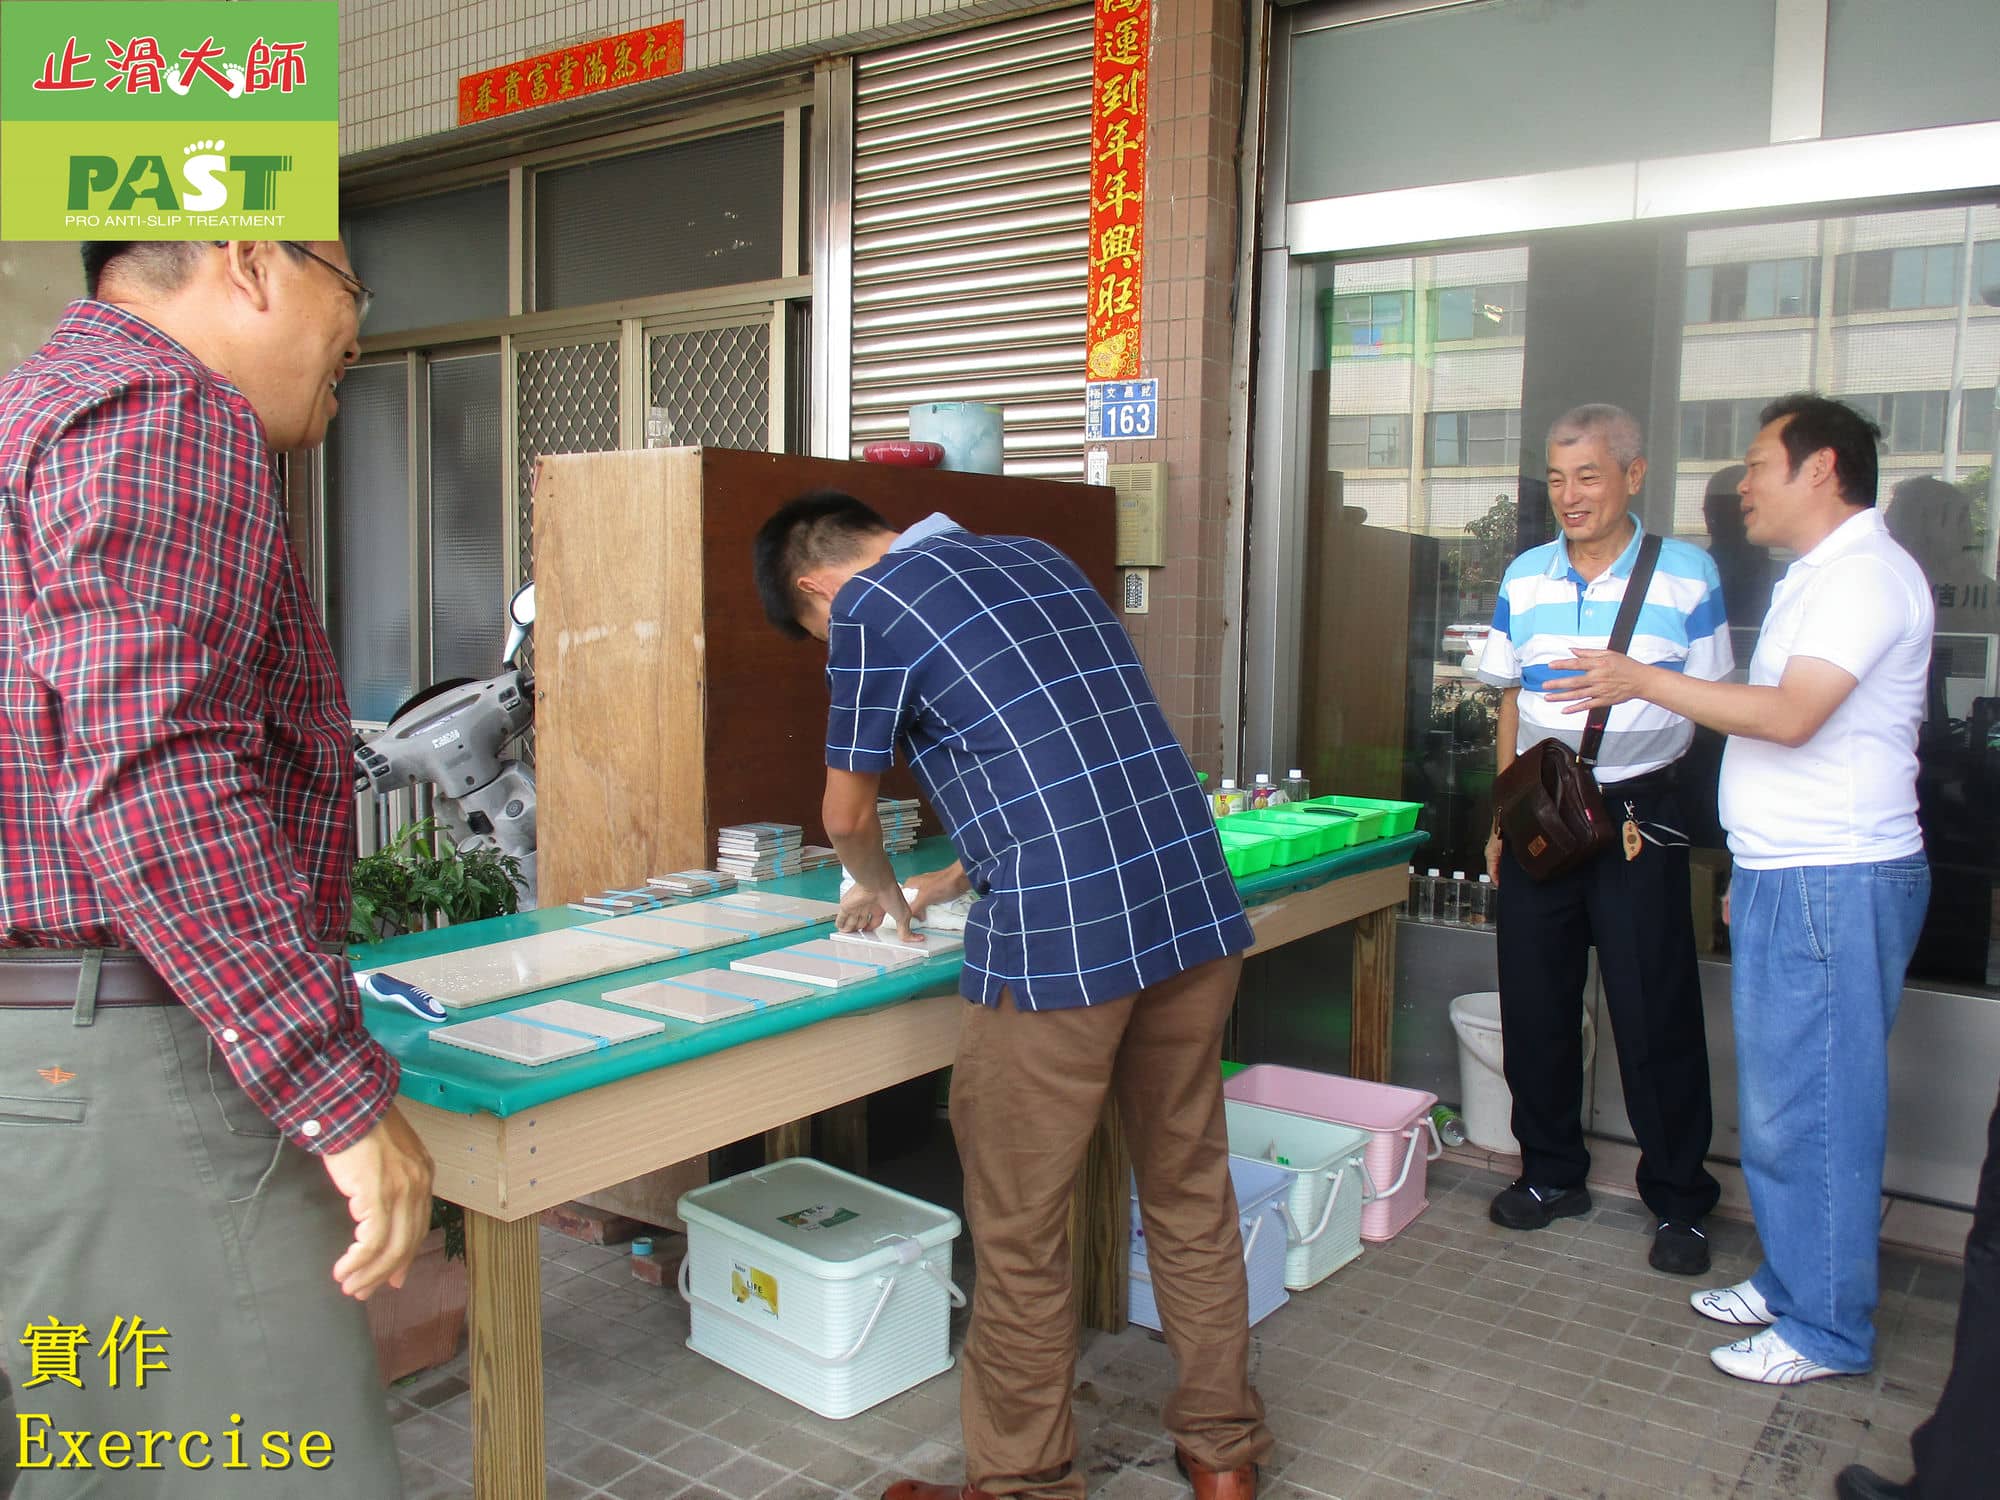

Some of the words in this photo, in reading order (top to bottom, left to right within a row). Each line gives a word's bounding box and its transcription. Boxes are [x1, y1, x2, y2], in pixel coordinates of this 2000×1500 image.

[1096, 0, 1141, 318] 運到年年興旺
[1107, 403, 1151, 436] 163
